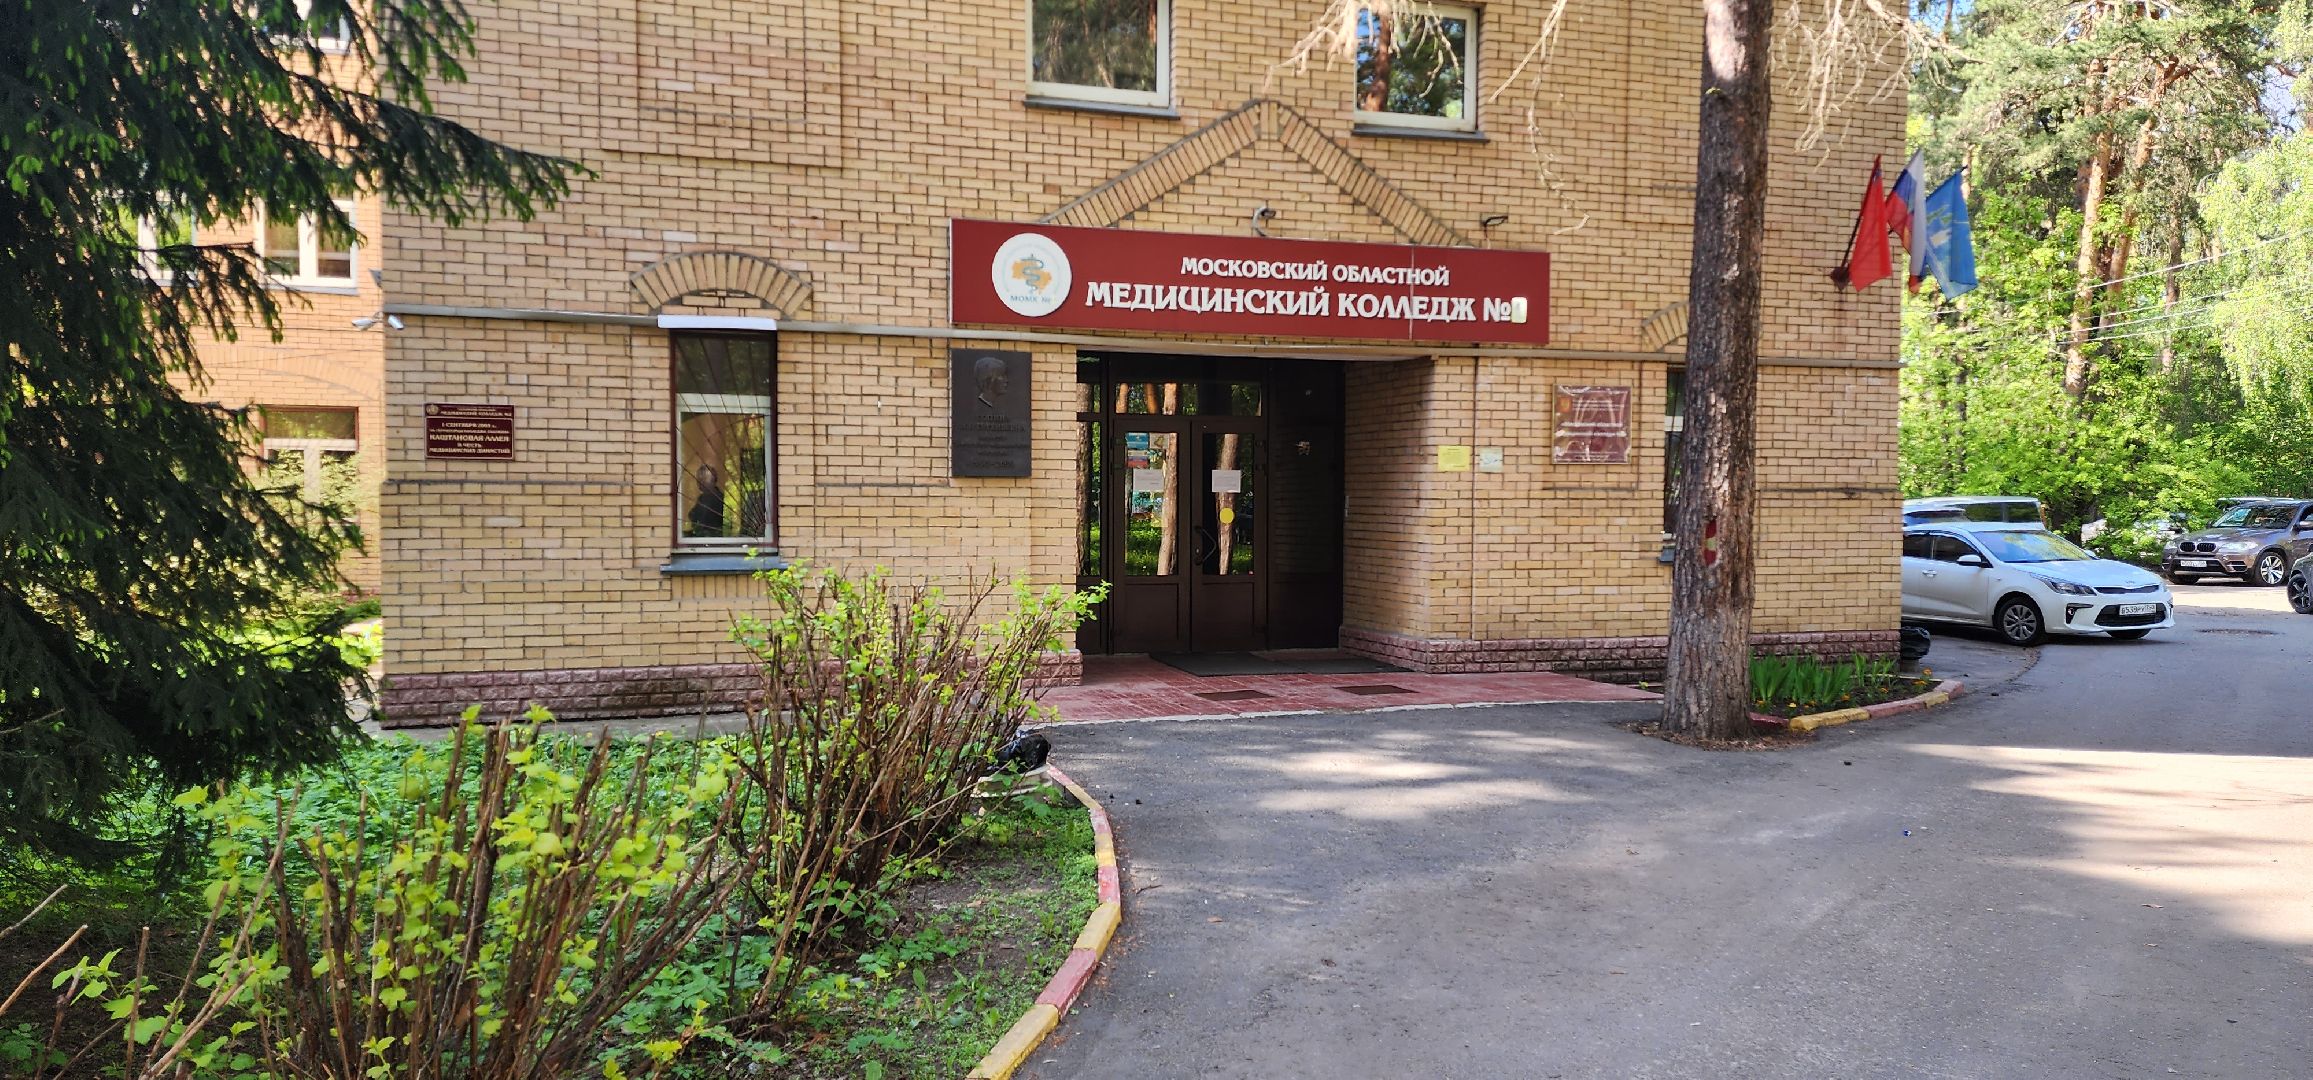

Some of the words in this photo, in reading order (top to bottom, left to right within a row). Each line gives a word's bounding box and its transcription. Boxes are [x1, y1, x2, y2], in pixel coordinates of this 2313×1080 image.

[1180, 256, 1328, 281] МОСКОВСКИЙ
[1331, 264, 1450, 286] ОБЛАСТНОЙ
[1085, 281, 1330, 316] МЕДИЦИНСКИЙ
[1337, 292, 1477, 323] КОЛЛЕДЖ
